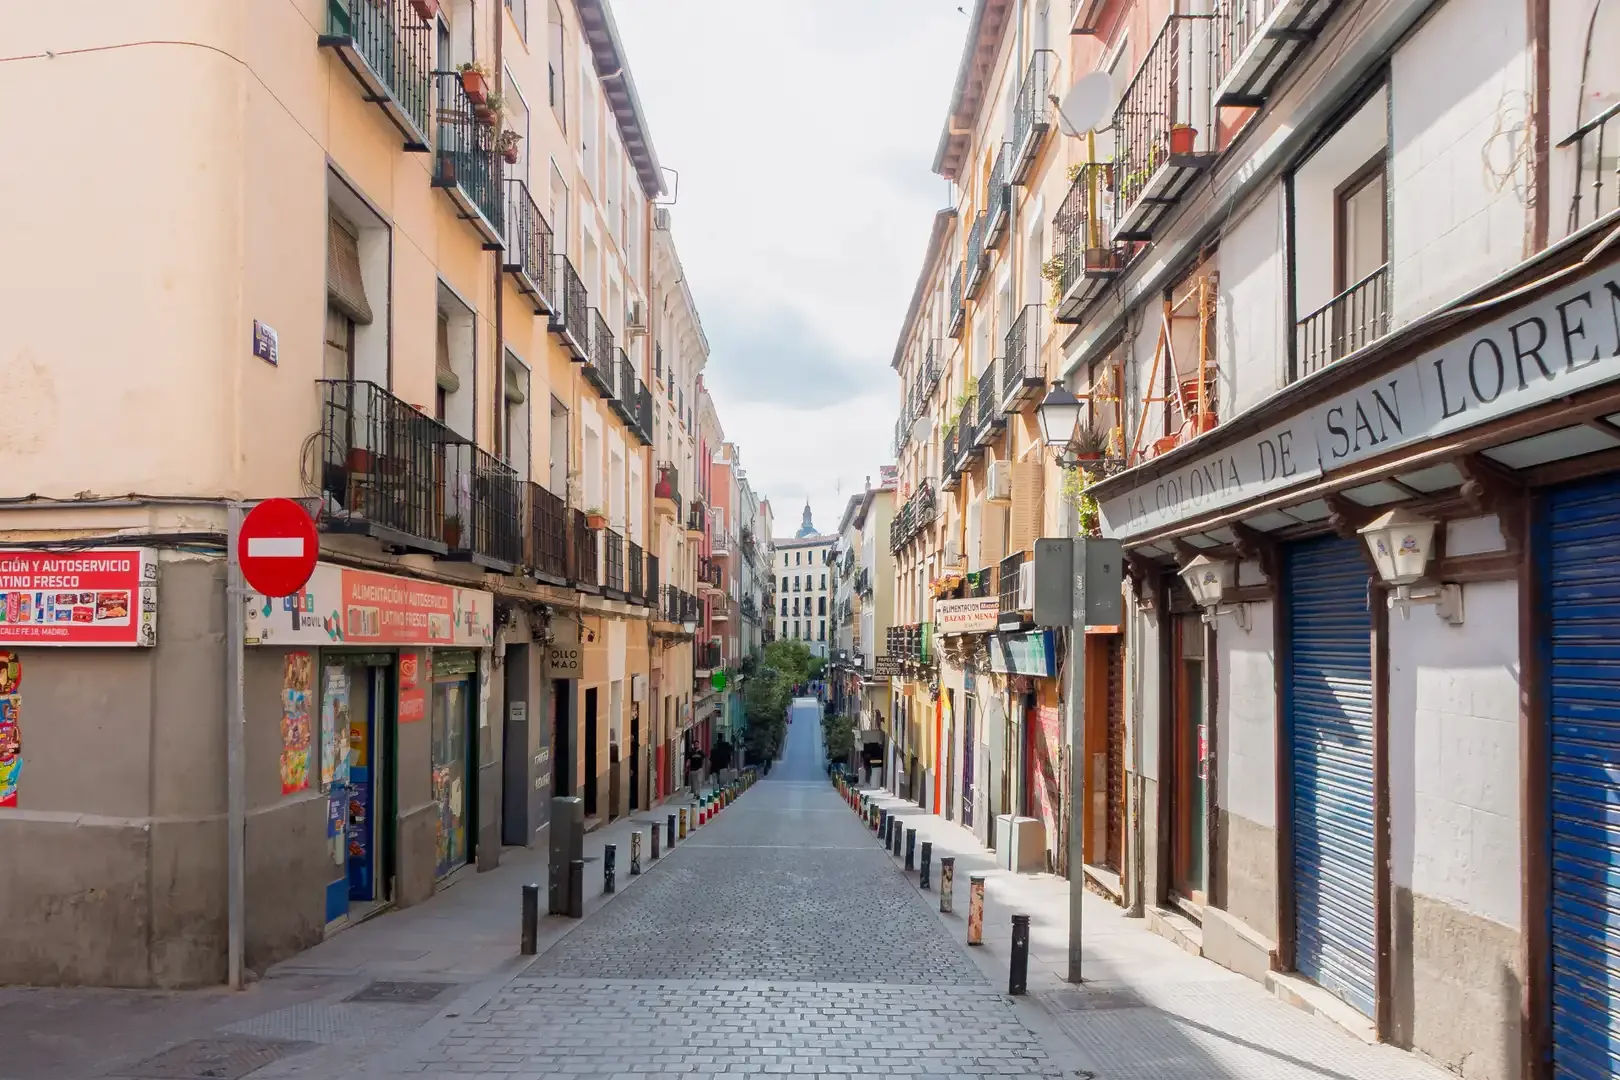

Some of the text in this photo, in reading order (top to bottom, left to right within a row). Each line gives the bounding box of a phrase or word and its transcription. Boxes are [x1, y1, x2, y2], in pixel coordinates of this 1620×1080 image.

[1128, 497, 1148, 526] LA
[1156, 455, 1244, 519] COLONIA
[1258, 430, 1297, 483] DE
[1327, 380, 1404, 458] SAN
[0, 557, 131, 572] CIÓN Y AUTOSERVICIO
[33, 575, 80, 588] FRESCO
[352, 583, 404, 605] ALIMENTACIÓN
[409, 592, 448, 609] AUTOSERVICIO
[381, 609, 427, 628] LATINO FRESCO
[0, 627, 21, 636] CALLE
[551, 650, 578, 659] OLLO
[551, 660, 578, 669] MAO
